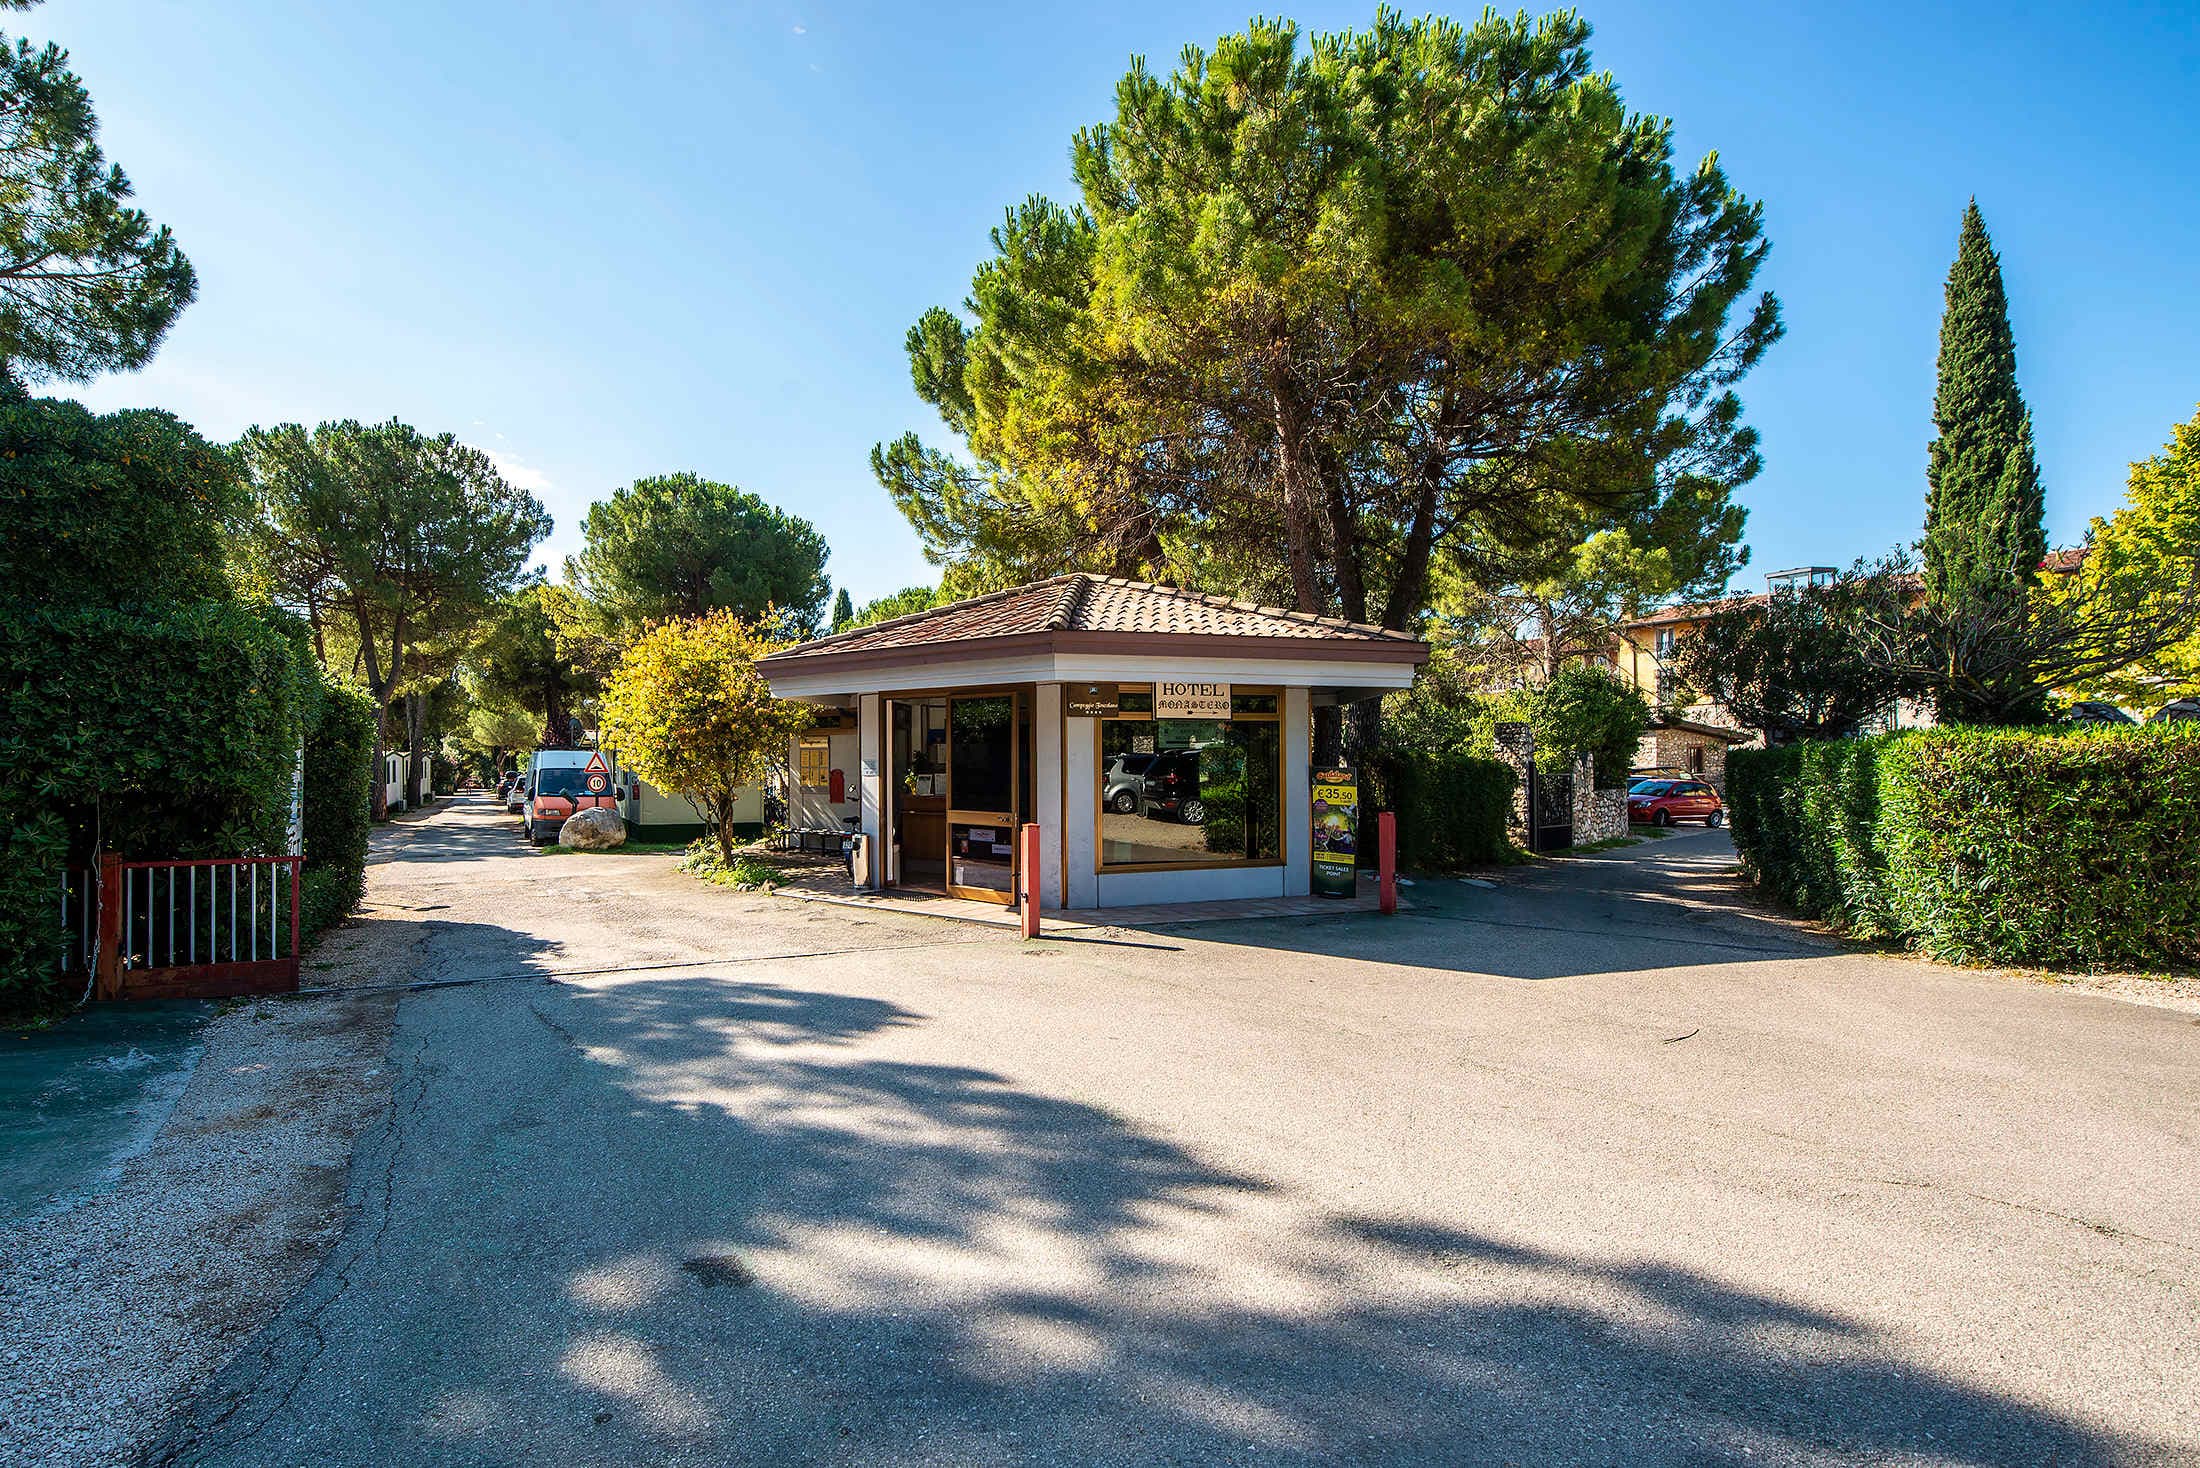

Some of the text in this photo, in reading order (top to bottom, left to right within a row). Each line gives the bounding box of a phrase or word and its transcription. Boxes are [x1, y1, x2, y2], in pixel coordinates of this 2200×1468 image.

[1163, 683, 1225, 697] HOTEL
[1158, 699, 1230, 710] MONASTERO
[592, 779, 602, 787] 10
